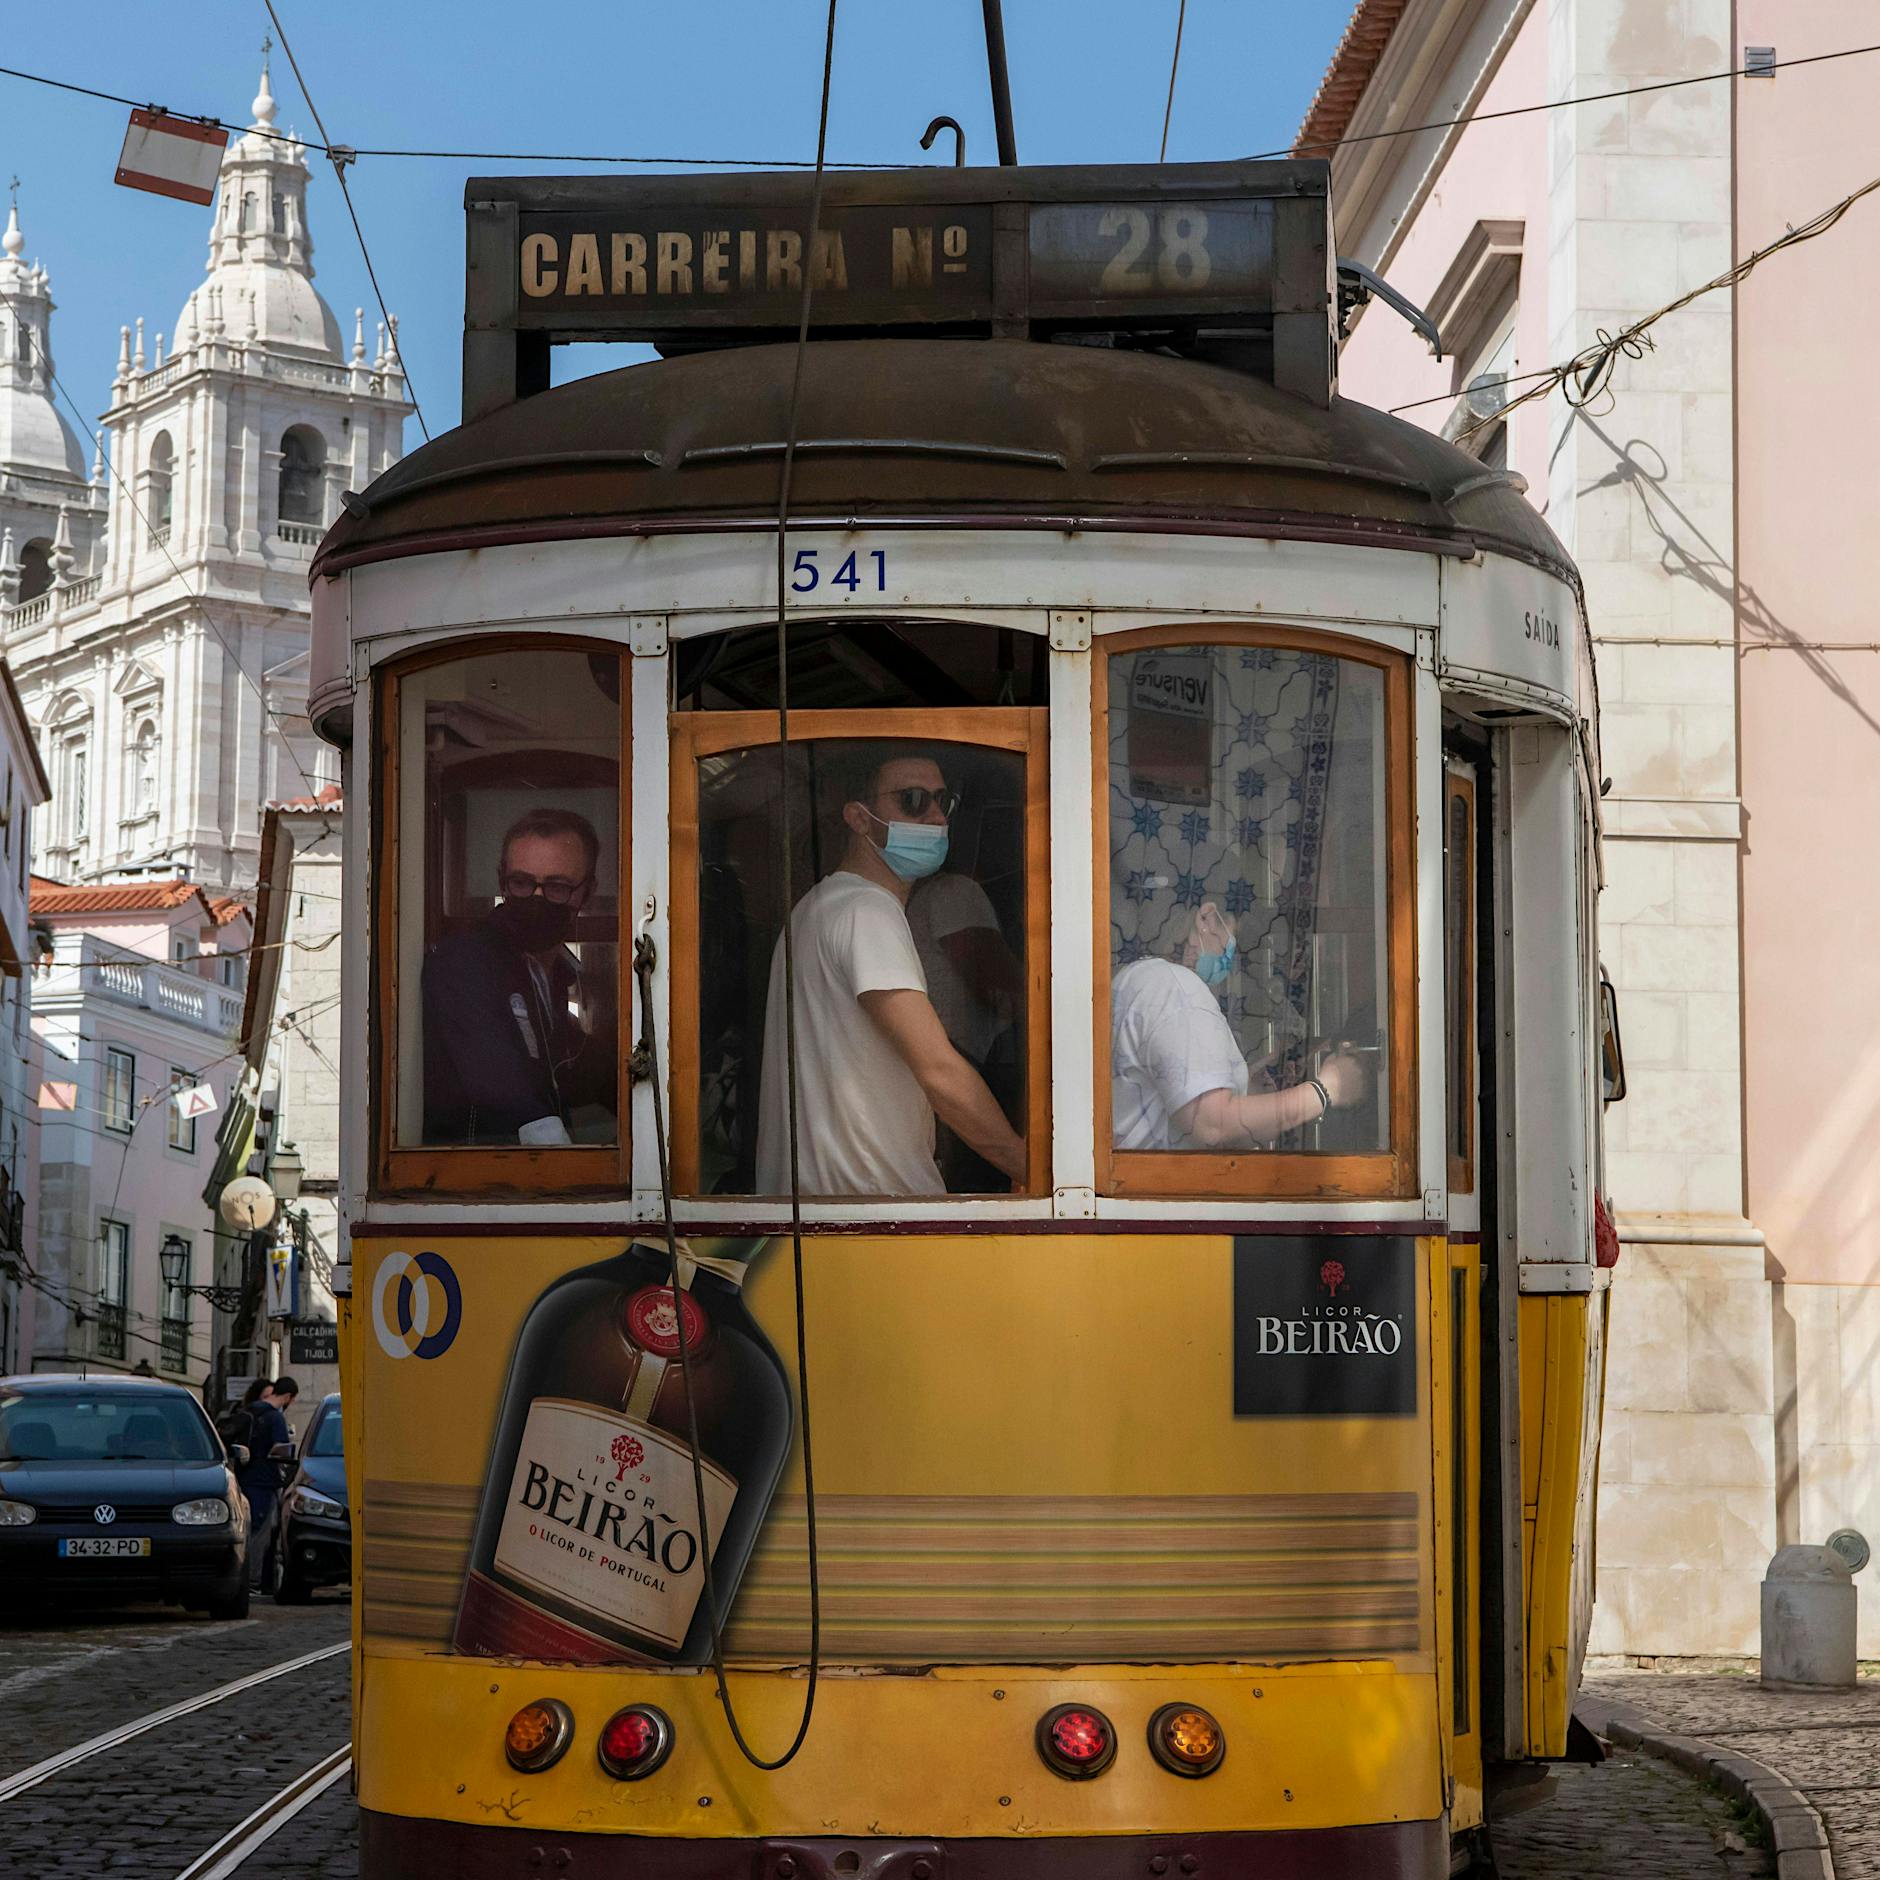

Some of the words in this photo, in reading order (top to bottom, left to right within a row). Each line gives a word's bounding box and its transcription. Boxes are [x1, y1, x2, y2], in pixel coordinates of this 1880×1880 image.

[520, 229, 849, 298] CARREIRA
[1098, 206, 1213, 294] 28
[792, 550, 887, 592] 541
[1525, 608, 1560, 651] SAÍDA
[1302, 1306, 1362, 1316] LICOR
[304, 1348, 334, 1359] TIJOLO
[1256, 1314, 1401, 1355] BEIRÃO
[577, 1467, 655, 1510] LICOR
[595, 1454, 605, 1465] 19
[639, 1473, 651, 1484] 29
[519, 1459, 697, 1574] BEIRÃO
[529, 1524, 537, 1536] O
[539, 1527, 575, 1553] LICOR
[579, 1546, 595, 1562] DE
[600, 1556, 666, 1592] PORTUGAL
